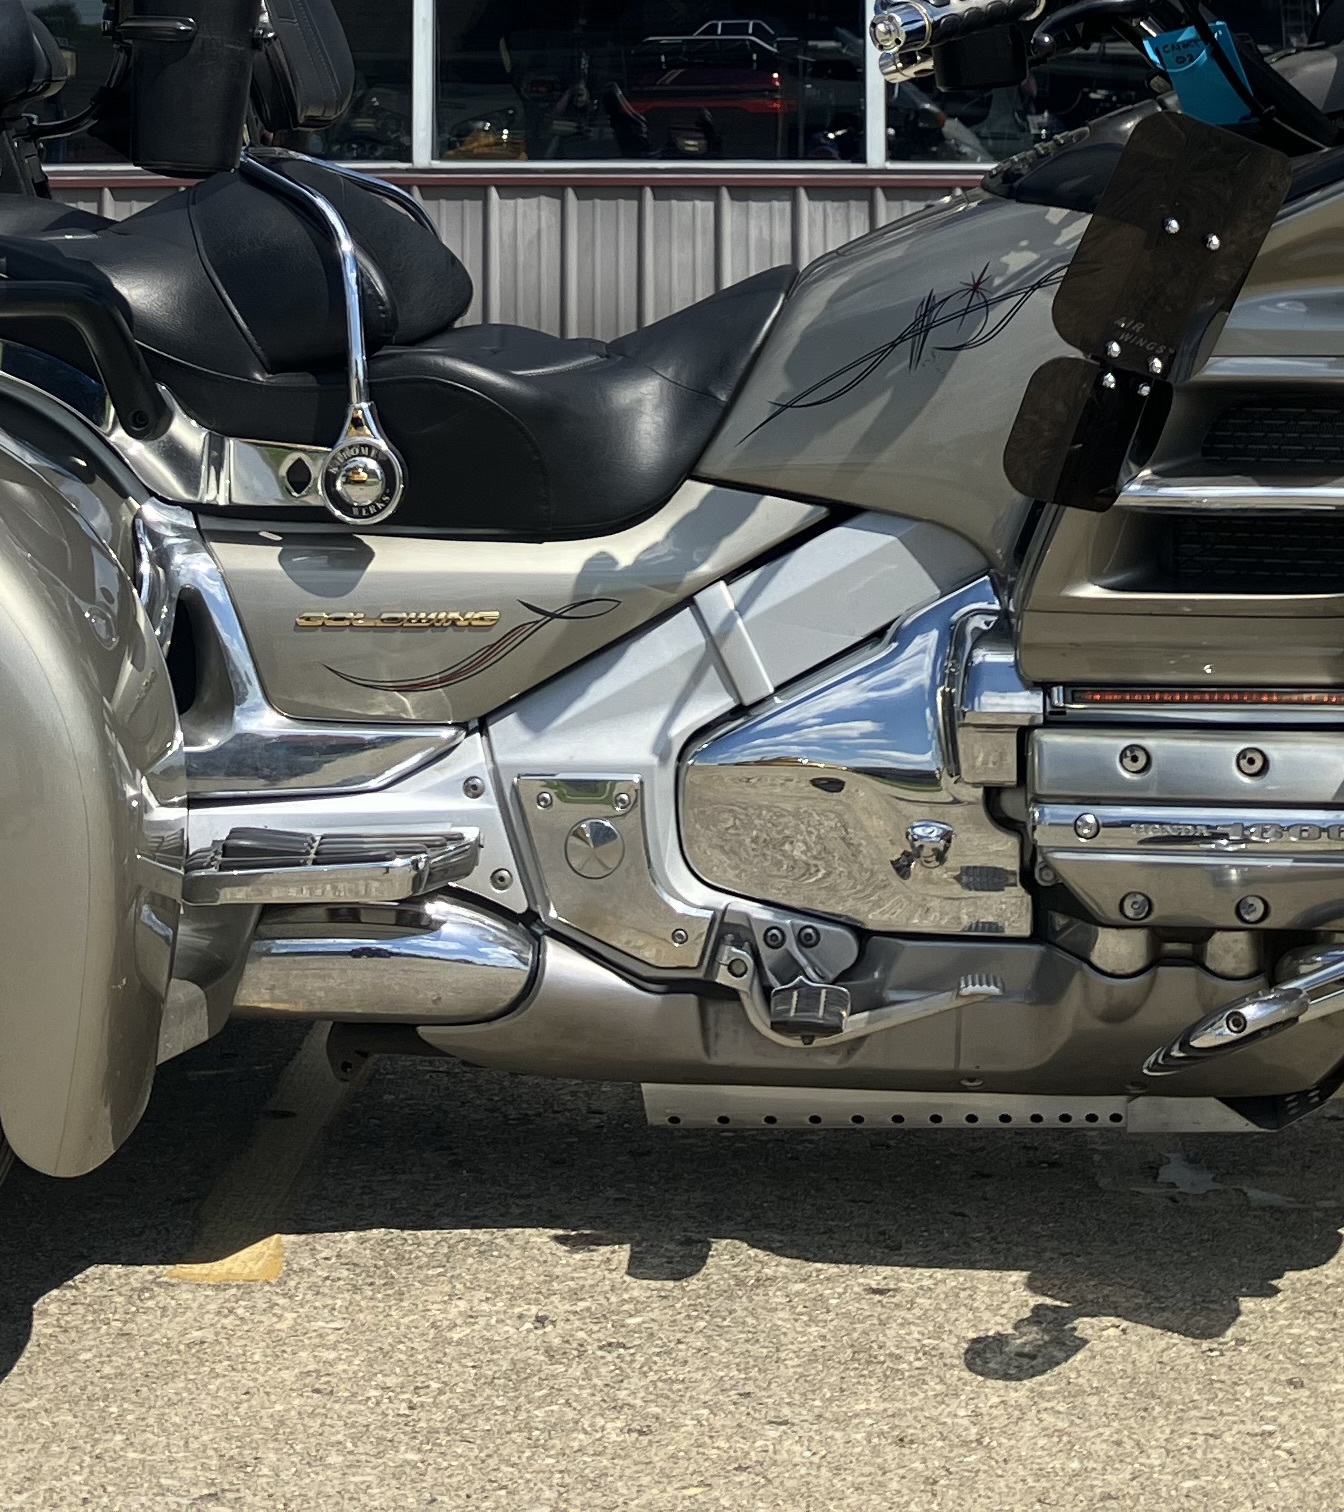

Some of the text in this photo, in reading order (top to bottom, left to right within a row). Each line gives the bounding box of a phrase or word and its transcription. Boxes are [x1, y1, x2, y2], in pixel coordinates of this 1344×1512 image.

[1114, 317, 1145, 333] AIR
[295, 610, 500, 628] GOLDWING
[1130, 823, 1212, 837] HONDA
